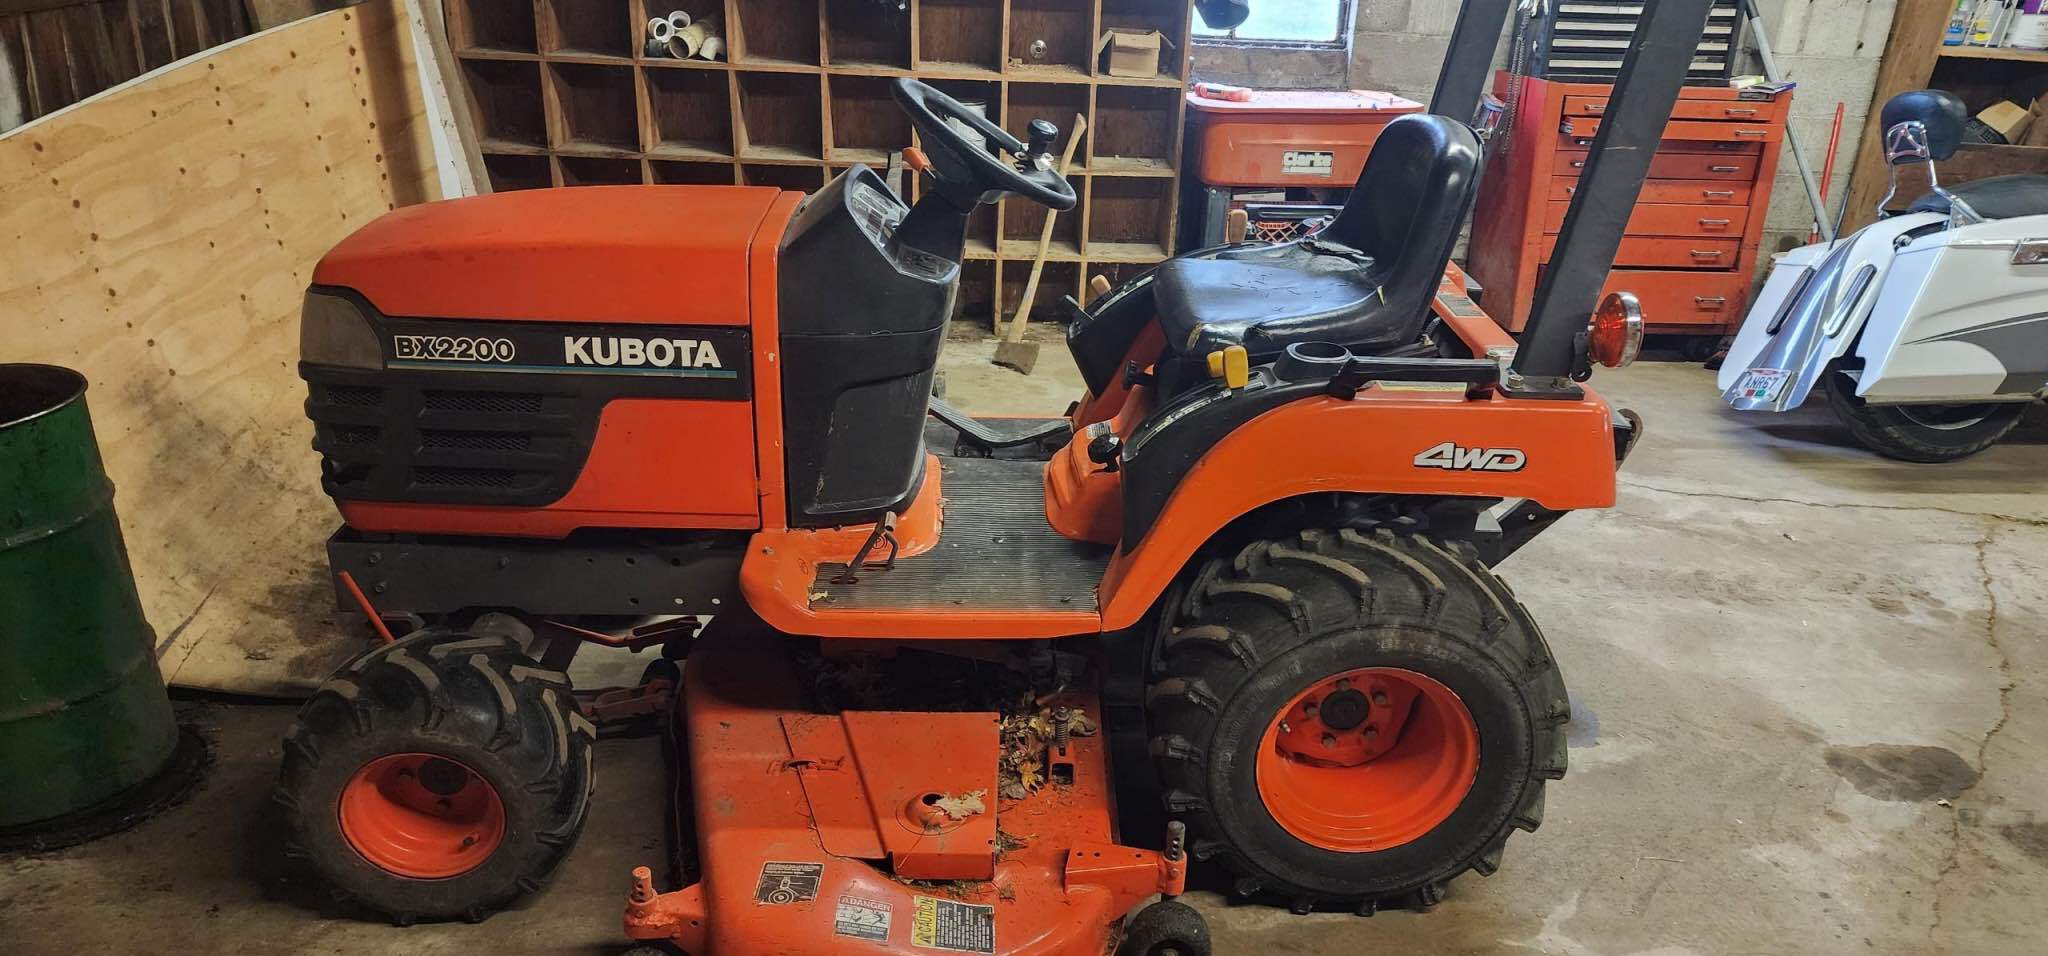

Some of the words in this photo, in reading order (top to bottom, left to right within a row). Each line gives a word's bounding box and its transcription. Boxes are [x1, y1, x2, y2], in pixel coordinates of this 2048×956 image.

[393, 335, 516, 362] BX2200
[564, 336, 722, 368] KUBOTA
[1413, 441, 1527, 472] 4WD
[849, 898, 891, 912] DANGER
[919, 898, 935, 933] CAUTION
